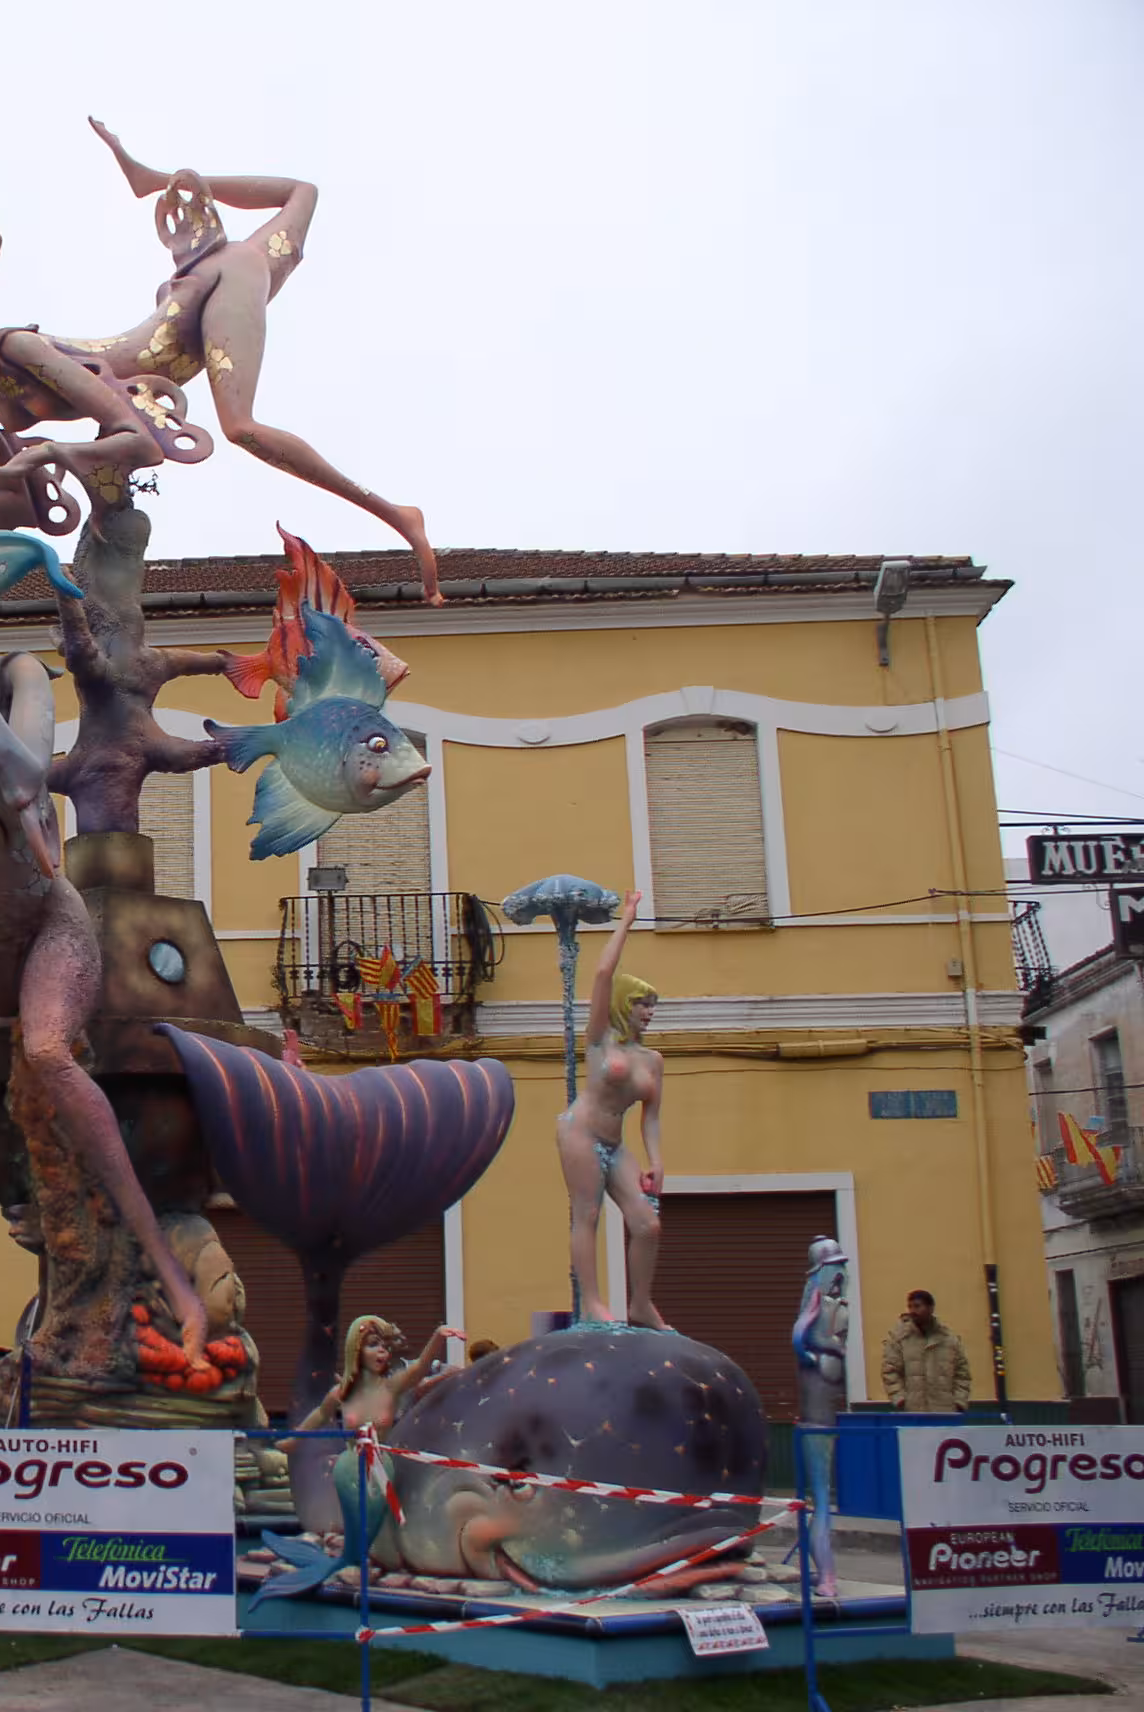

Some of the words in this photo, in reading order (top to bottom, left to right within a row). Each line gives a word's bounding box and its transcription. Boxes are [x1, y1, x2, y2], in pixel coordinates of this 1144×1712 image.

[1005, 1433, 1085, 1447] AUTO-HIFI
[933, 1438, 1144, 1494] Progreso
[1008, 1501, 1051, 1513] SERVICIO
[45, 1513, 91, 1524] OFICIAL
[929, 1543, 1041, 1571] Pioneer
[2, 1577, 36, 1586] SHOP
[98, 1564, 217, 1590] MoviStar
[12, 1603, 41, 1616] con
[49, 1600, 75, 1617] las
[82, 1597, 154, 1622] Fallas
[1043, 1602, 1066, 1614] con
[1072, 1598, 1094, 1613] las
